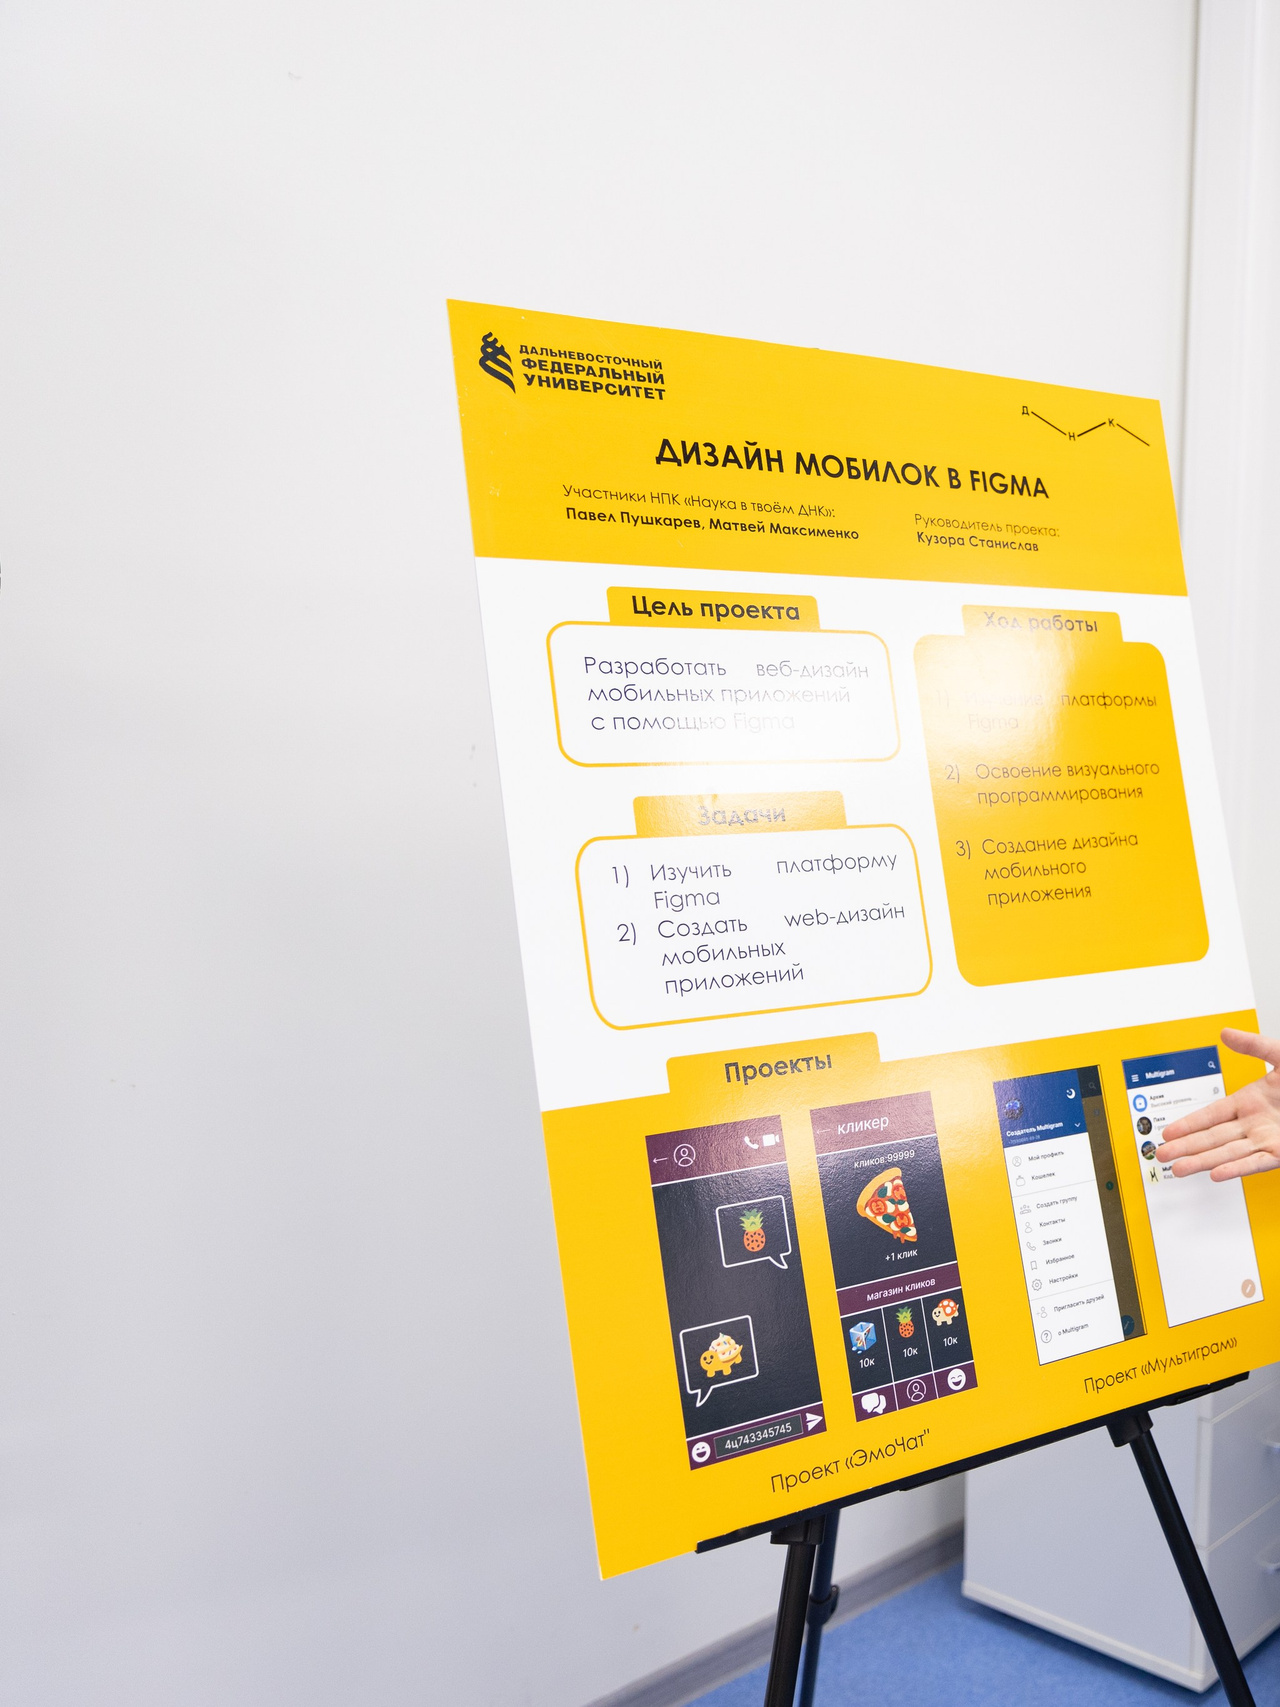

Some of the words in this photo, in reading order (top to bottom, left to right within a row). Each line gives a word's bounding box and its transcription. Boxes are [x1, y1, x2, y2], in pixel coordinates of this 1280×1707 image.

[519, 344, 663, 370] ДАЛЬНЕВОСТОЧНЫЙ
[521, 357, 665, 385] ФЕДЕРАЛЬНЫЙ
[523, 373, 666, 400] УНИВЕРСИТЕТ
[655, 438, 784, 473] ДИЗАЙН
[795, 451, 940, 488] МОБИЛОК
[947, 467, 962, 489] В
[970, 470, 1049, 499] FIGMA
[562, 483, 647, 504] Участники
[650, 492, 681, 506] НПК
[684, 494, 737, 513] «Наука
[740, 501, 748, 511] в
[750, 500, 794, 515] твоём
[797, 503, 836, 518] ДНК»:
[565, 507, 617, 523] Павел
[621, 511, 706, 531] Пушкарев,
[708, 518, 766, 534] Матвей
[769, 523, 859, 540] Максименко
[914, 513, 1003, 533] Руководитель
[1005, 521, 1060, 538] проекта:
[916, 531, 965, 548] Кузора
[968, 535, 1039, 552] Станислав
[631, 595, 693, 618] Цель
[700, 602, 801, 622] проекта
[983, 611, 1022, 631] Ход
[1028, 614, 1098, 633] работы
[583, 656, 727, 678] Разработать
[755, 660, 869, 679] веб-дизайн
[588, 683, 715, 702] мобильных
[721, 685, 851, 706] приложений
[1061, 692, 1157, 710] платформы
[591, 716, 606, 731] с
[613, 715, 727, 733] помощью
[733, 712, 795, 733] Figma
[944, 764, 961, 783] 2)
[975, 763, 1062, 780] Освоение
[1067, 761, 1160, 780] визуального
[977, 787, 1143, 807] программирования
[698, 803, 786, 827] Задачи
[955, 840, 971, 859] 3)
[981, 837, 1067, 855] Создание
[1072, 831, 1138, 850] дизайна
[611, 865, 629, 888] 1)
[650, 863, 732, 884] Изучить
[776, 853, 897, 875] платформу
[984, 860, 1087, 880] мобильного
[653, 890, 721, 913] Figma
[987, 885, 1092, 909] приложения
[616, 922, 637, 945] 2)
[658, 918, 748, 939] Создать
[783, 903, 905, 927] web-дизайн
[662, 941, 786, 967] мобильных
[665, 963, 804, 997] приложений
[724, 1054, 833, 1086] Проекты
[1145, 1069, 1175, 1080] Multigram
[837, 1116, 890, 1136] кликер
[854, 1149, 916, 1169] кликов:99999
[1059, 1195, 1078, 1205] группу
[1039, 1217, 1066, 1228] Контакты
[1042, 1236, 1062, 1246] Звонки
[885, 1252, 896, 1262] +1
[897, 1248, 918, 1260] клик
[1045, 1253, 1075, 1265] Избранное
[866, 1284, 903, 1302] магазин
[905, 1277, 936, 1294] кликов
[1049, 1272, 1079, 1284] Настройки
[1053, 1300, 1085, 1313] Пригласить
[1086, 1294, 1105, 1306] друзей
[1062, 1323, 1089, 1335] Multigram
[902, 1346, 919, 1359] 10к
[943, 1335, 958, 1348] 10к
[859, 1356, 875, 1369] 10к
[1084, 1366, 1138, 1394] Проект
[1140, 1337, 1238, 1377] «Мультиграм»
[724, 1422, 793, 1450] 4ц743345745
[771, 1458, 840, 1493] Проект
